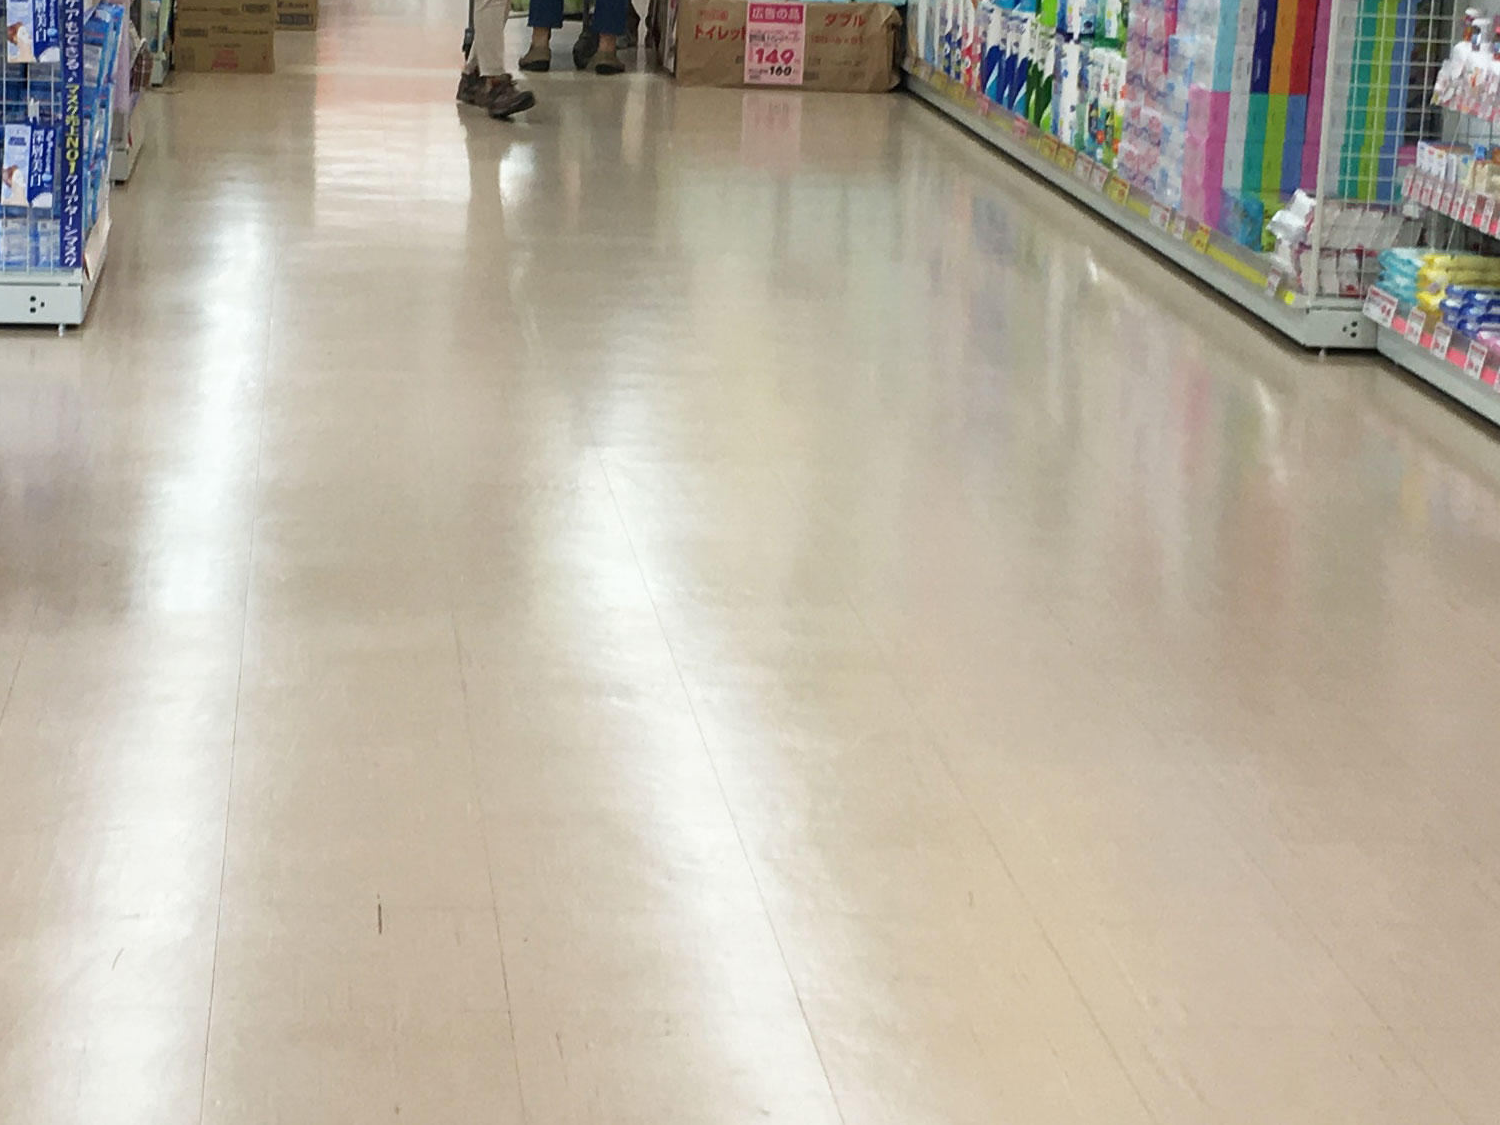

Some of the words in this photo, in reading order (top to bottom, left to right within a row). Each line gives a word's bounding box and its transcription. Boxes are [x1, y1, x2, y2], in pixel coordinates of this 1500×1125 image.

[751, 5, 801, 21] 広告の品
[824, 13, 867, 27] ダブル
[754, 48, 795, 65] 149
